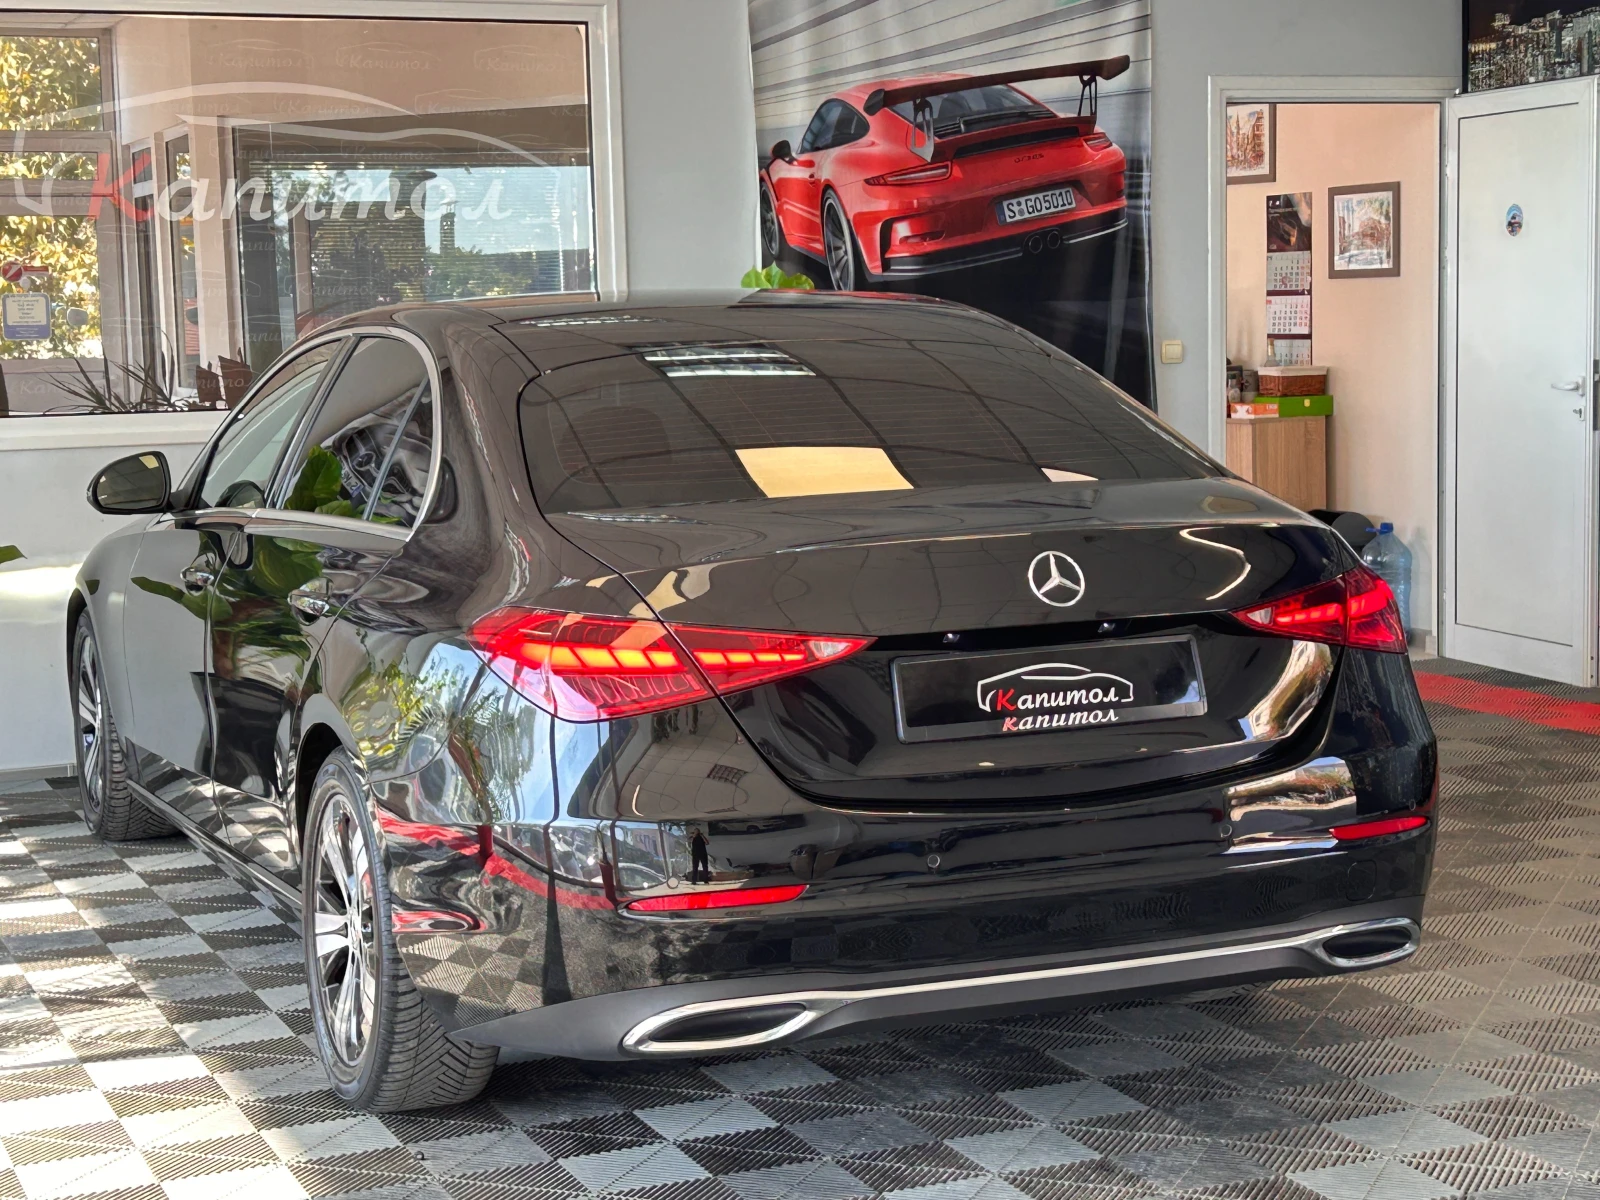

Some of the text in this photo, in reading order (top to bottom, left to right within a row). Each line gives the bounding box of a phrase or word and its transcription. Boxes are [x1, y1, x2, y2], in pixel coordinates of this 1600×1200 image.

[349, 54, 431, 70] Капитол
[87, 152, 515, 223] Капитол
[996, 687, 1118, 711] Капитол
[1002, 709, 1119, 731] капитол
